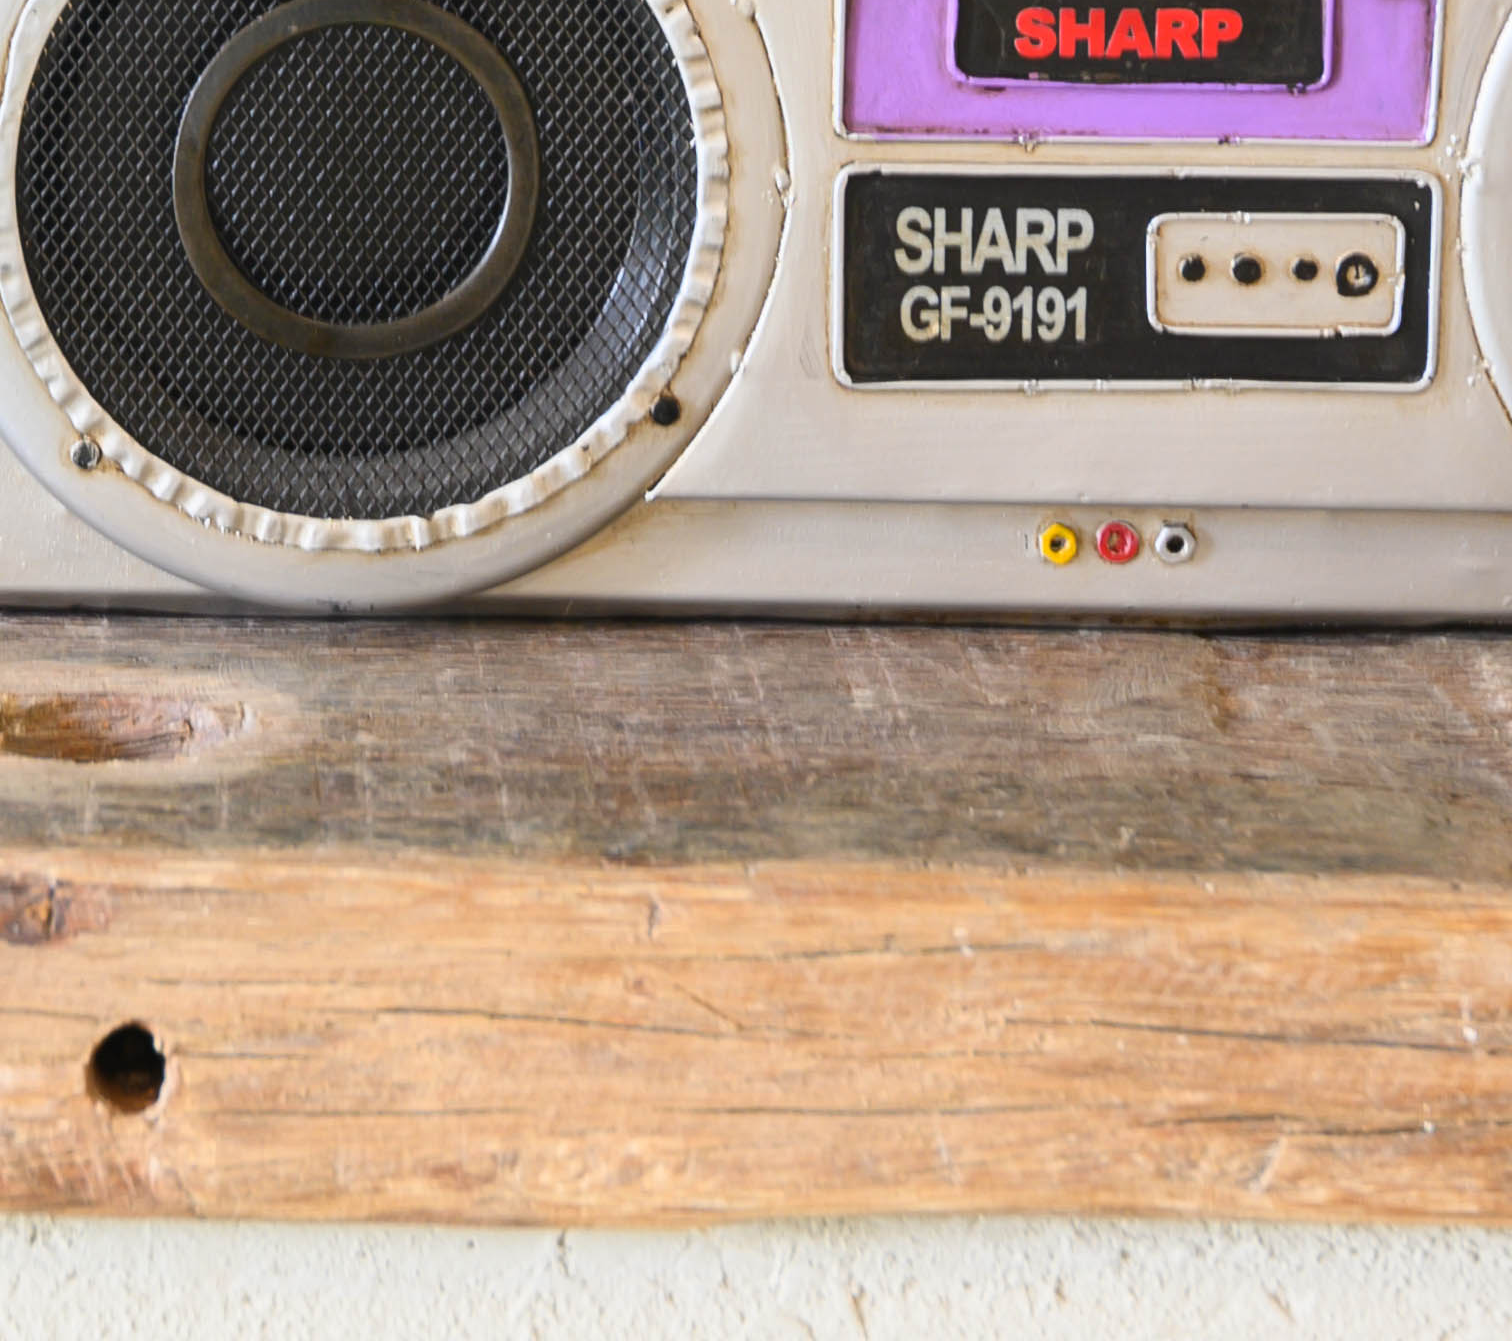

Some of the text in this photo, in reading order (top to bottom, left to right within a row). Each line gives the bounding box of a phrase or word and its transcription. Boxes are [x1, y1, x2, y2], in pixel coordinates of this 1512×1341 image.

[1014, 7, 1243, 60] SHARP
[894, 206, 1094, 275] SHARP
[899, 285, 1088, 343] GF-9191
